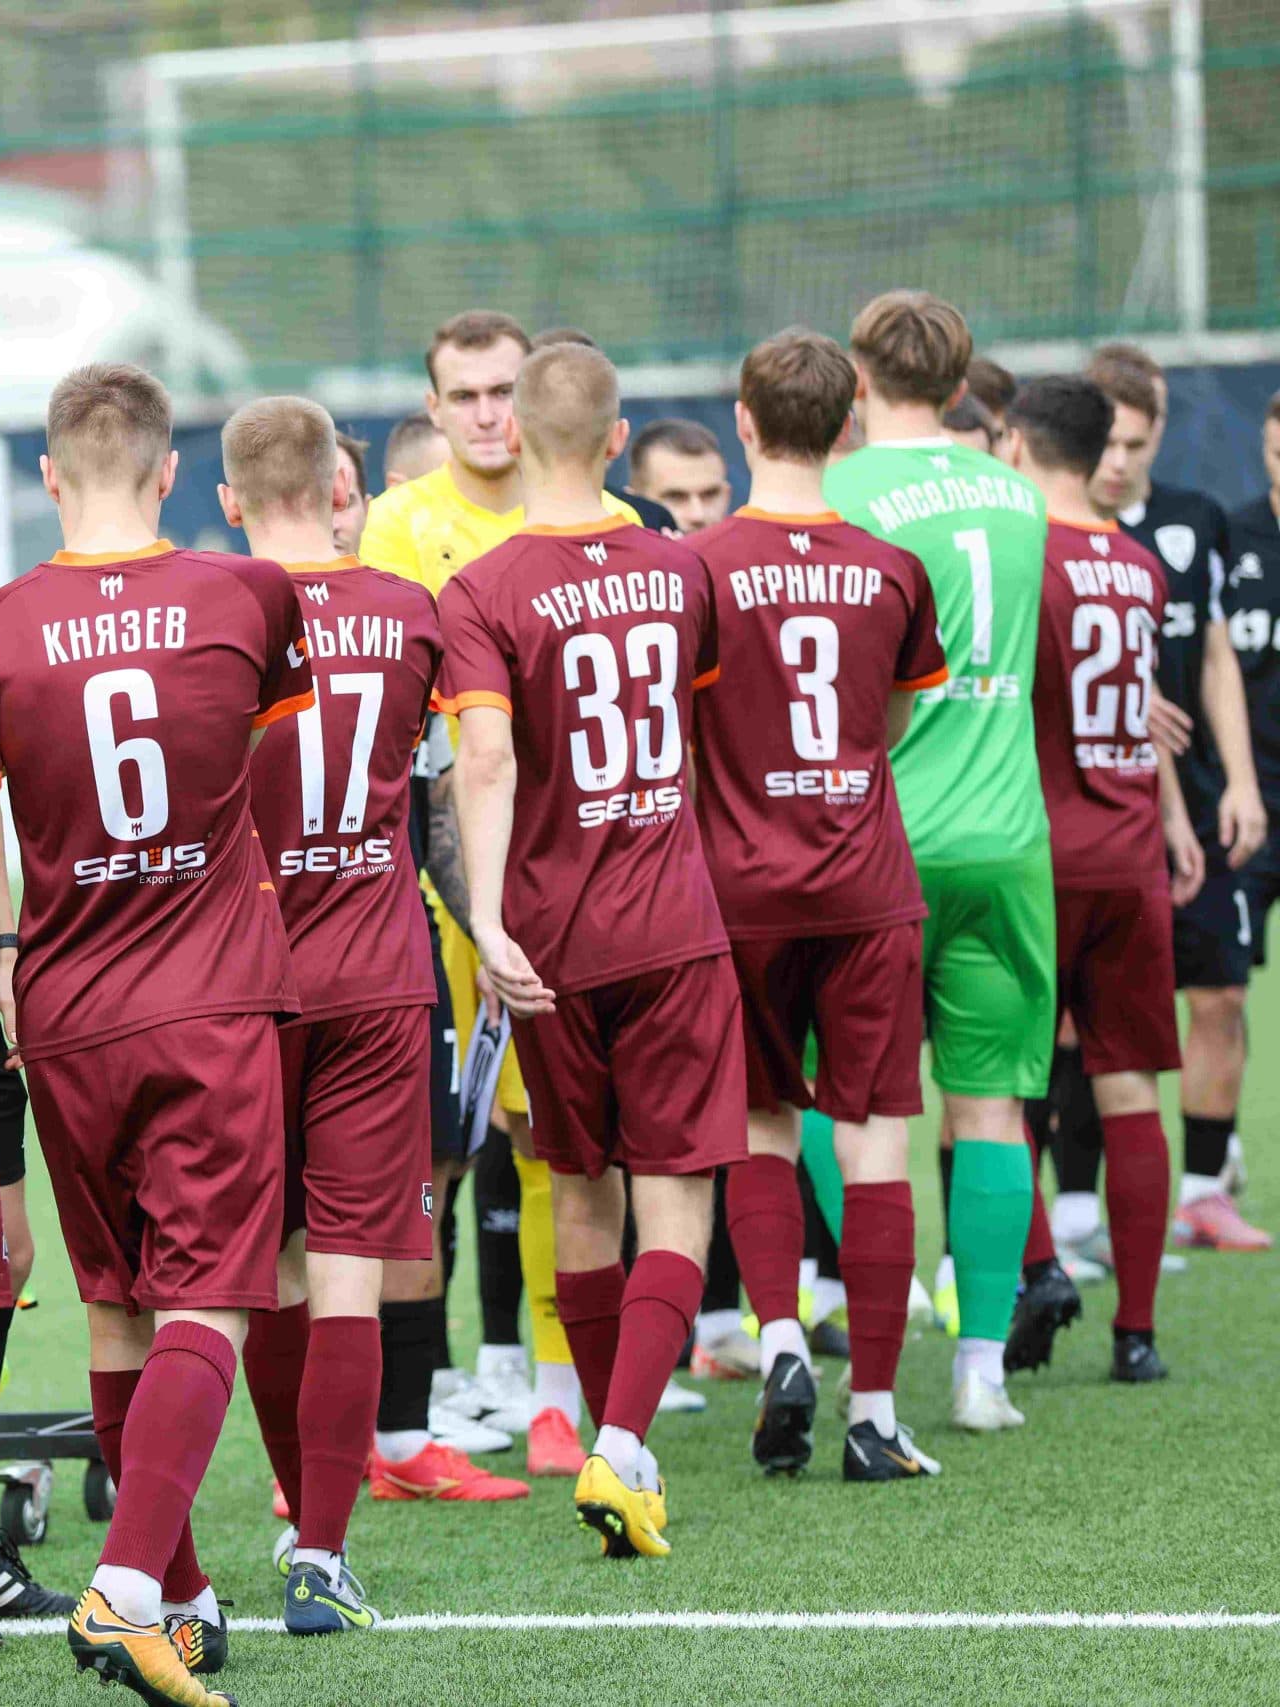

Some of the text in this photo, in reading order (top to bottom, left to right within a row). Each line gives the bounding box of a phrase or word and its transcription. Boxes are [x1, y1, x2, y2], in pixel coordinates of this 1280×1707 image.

[531, 570, 684, 630] ЧЕРКАСОВ
[729, 564, 882, 612] ВЕРНИГОР
[952, 528, 993, 666] 1
[42, 606, 187, 666] КНЯЗЕВ
[779, 615, 839, 761] 3
[1071, 603, 1158, 738] 23
[562, 621, 683, 792] 33
[83, 668, 169, 841] 6
[297, 672, 385, 836] 17
[765, 768, 870, 797] SEUS
[578, 786, 682, 828] SEUS
[73, 842, 206, 885] SEUS
[139, 869, 206, 886] Export Union
[279, 838, 392, 876] SEUS
[336, 864, 395, 880] Export Union
